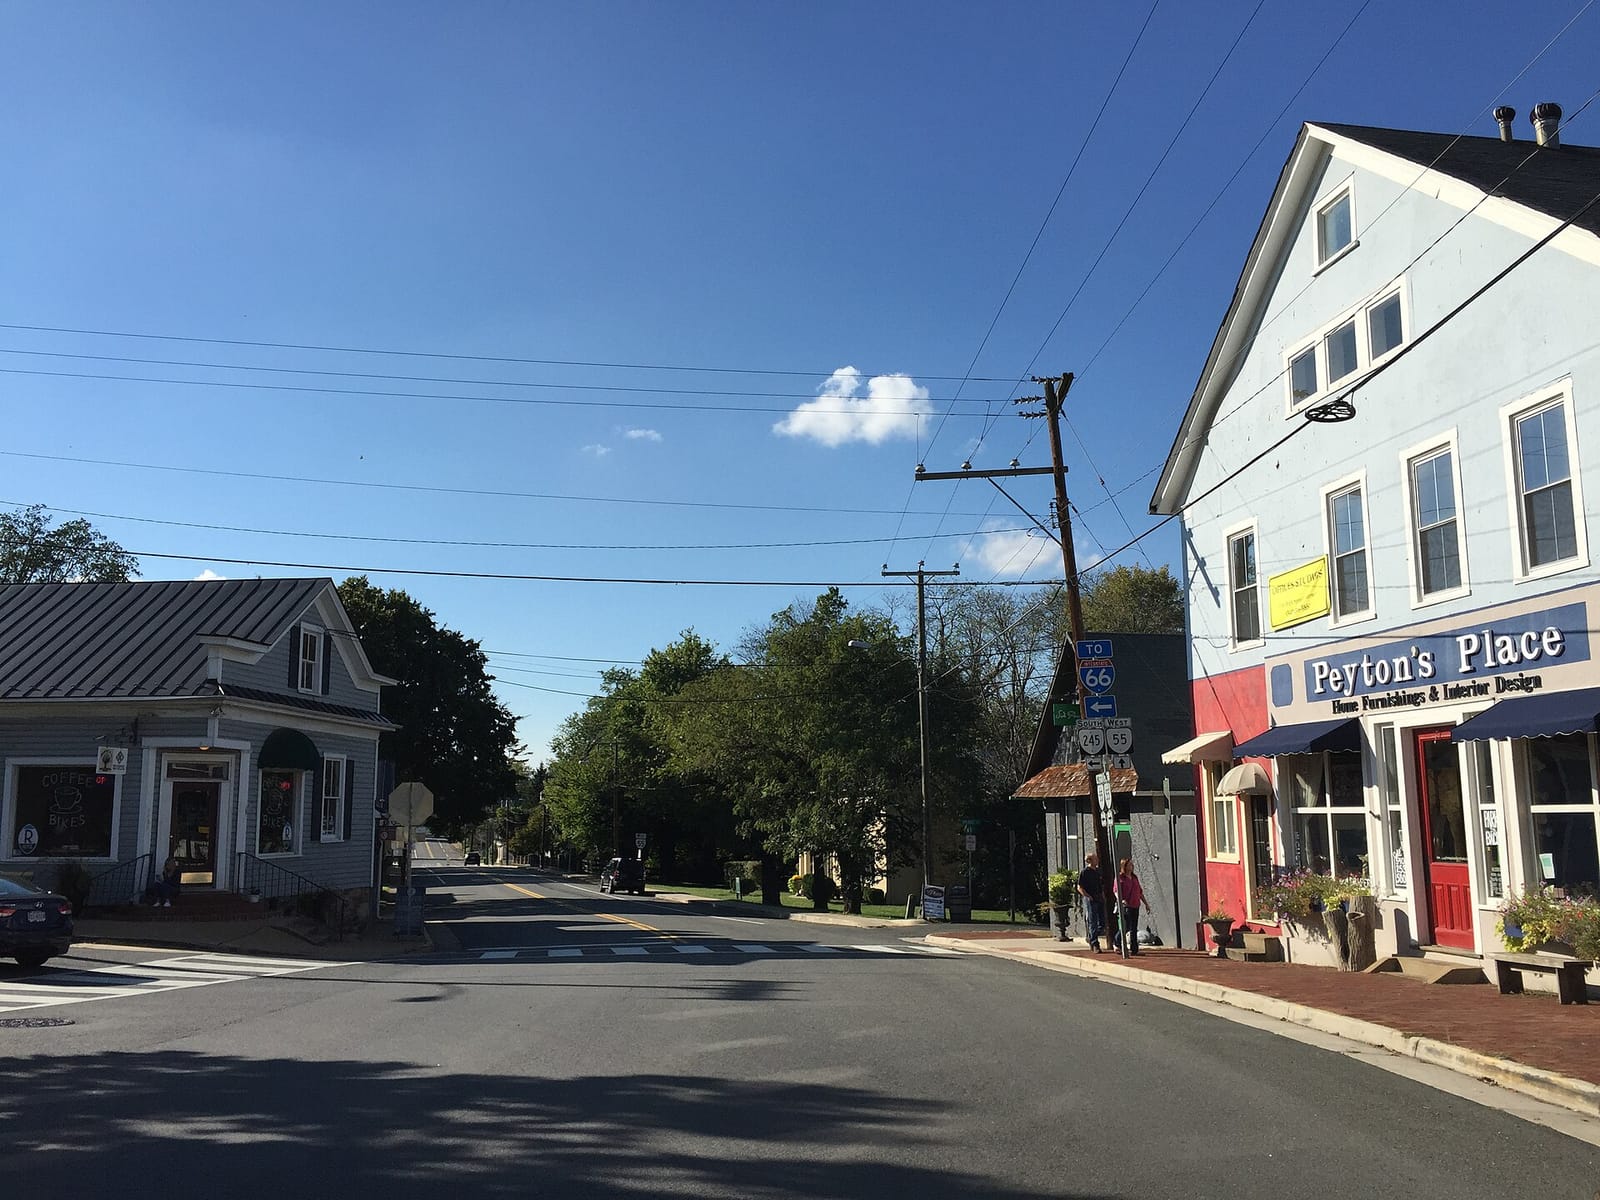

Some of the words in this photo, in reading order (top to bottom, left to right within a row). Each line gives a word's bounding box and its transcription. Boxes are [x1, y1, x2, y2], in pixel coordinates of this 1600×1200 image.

[1085, 644, 1103, 655] TO
[1312, 645, 1434, 697] Peyton's
[1456, 626, 1565, 673] Place
[1085, 668, 1111, 687] 66
[1332, 699, 1360, 714] Home
[1361, 690, 1426, 711] Furnishings
[1428, 685, 1440, 702] &
[1442, 680, 1491, 701] Interior
[1494, 672, 1543, 693] Design
[1107, 719, 1129, 727] WEST
[1083, 734, 1101, 747] 245
[1112, 733, 1128, 746] 55
[41, 772, 93, 788] COFFEE
[48, 814, 86, 831] BIKES
